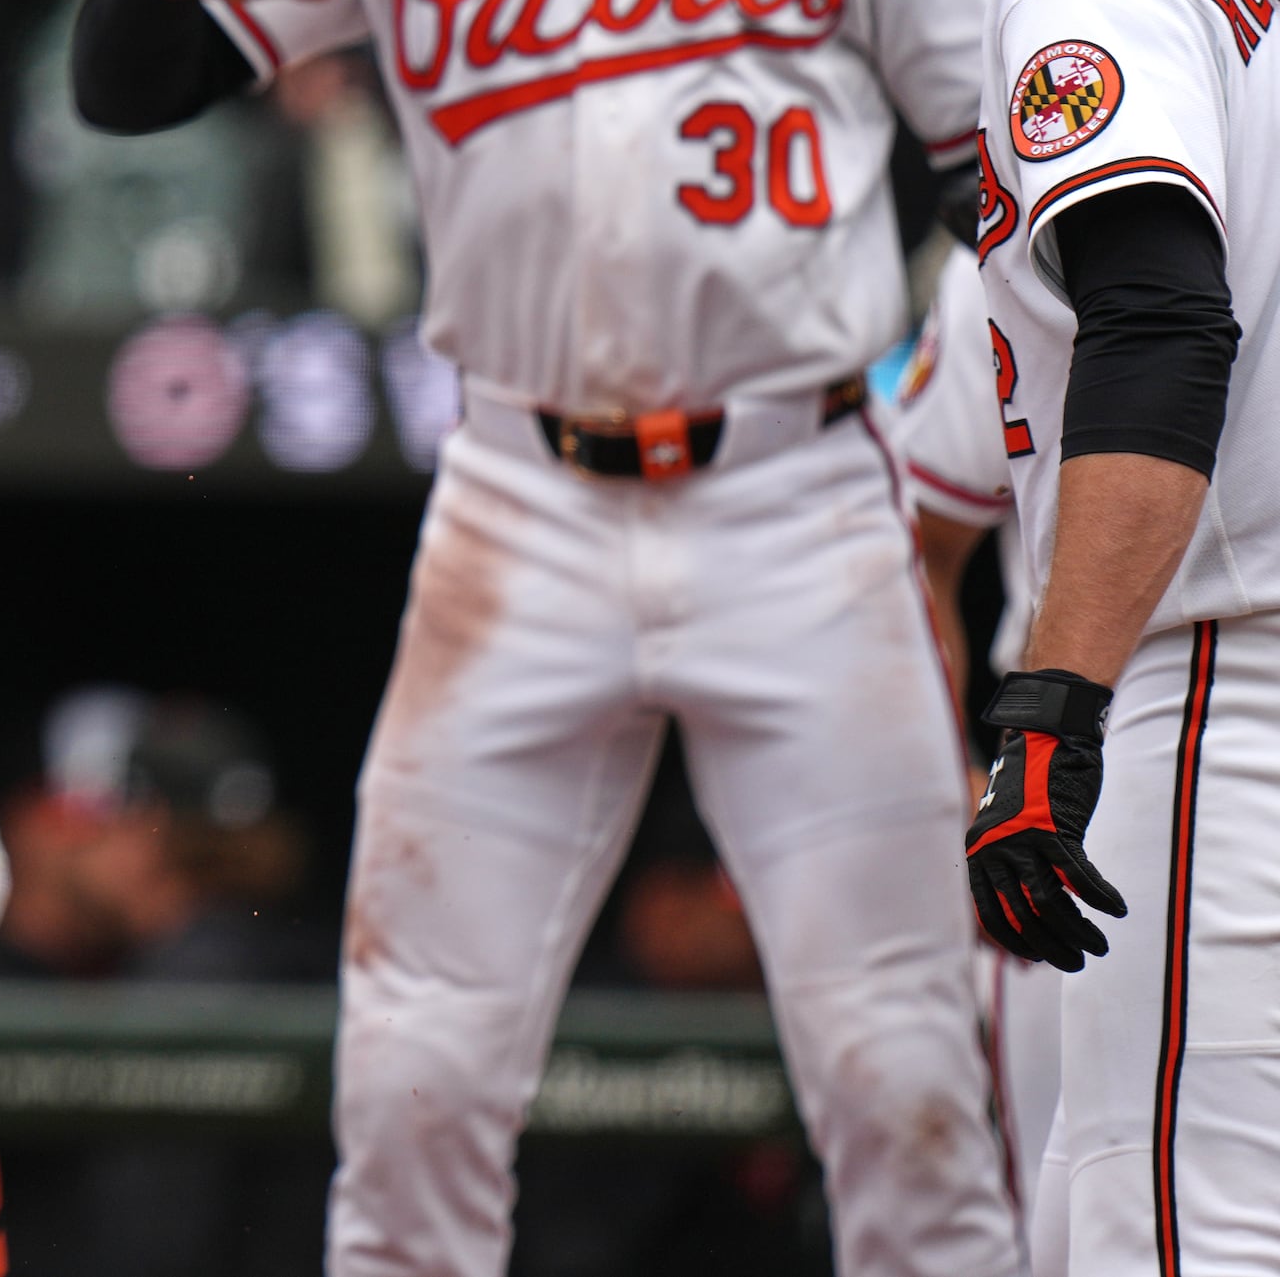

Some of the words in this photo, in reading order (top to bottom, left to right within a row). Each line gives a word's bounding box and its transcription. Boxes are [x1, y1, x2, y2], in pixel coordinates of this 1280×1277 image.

[1011, 44, 1106, 115] BALTIMORE
[677, 101, 834, 228] 30
[1030, 108, 1109, 155] ORIOLES
